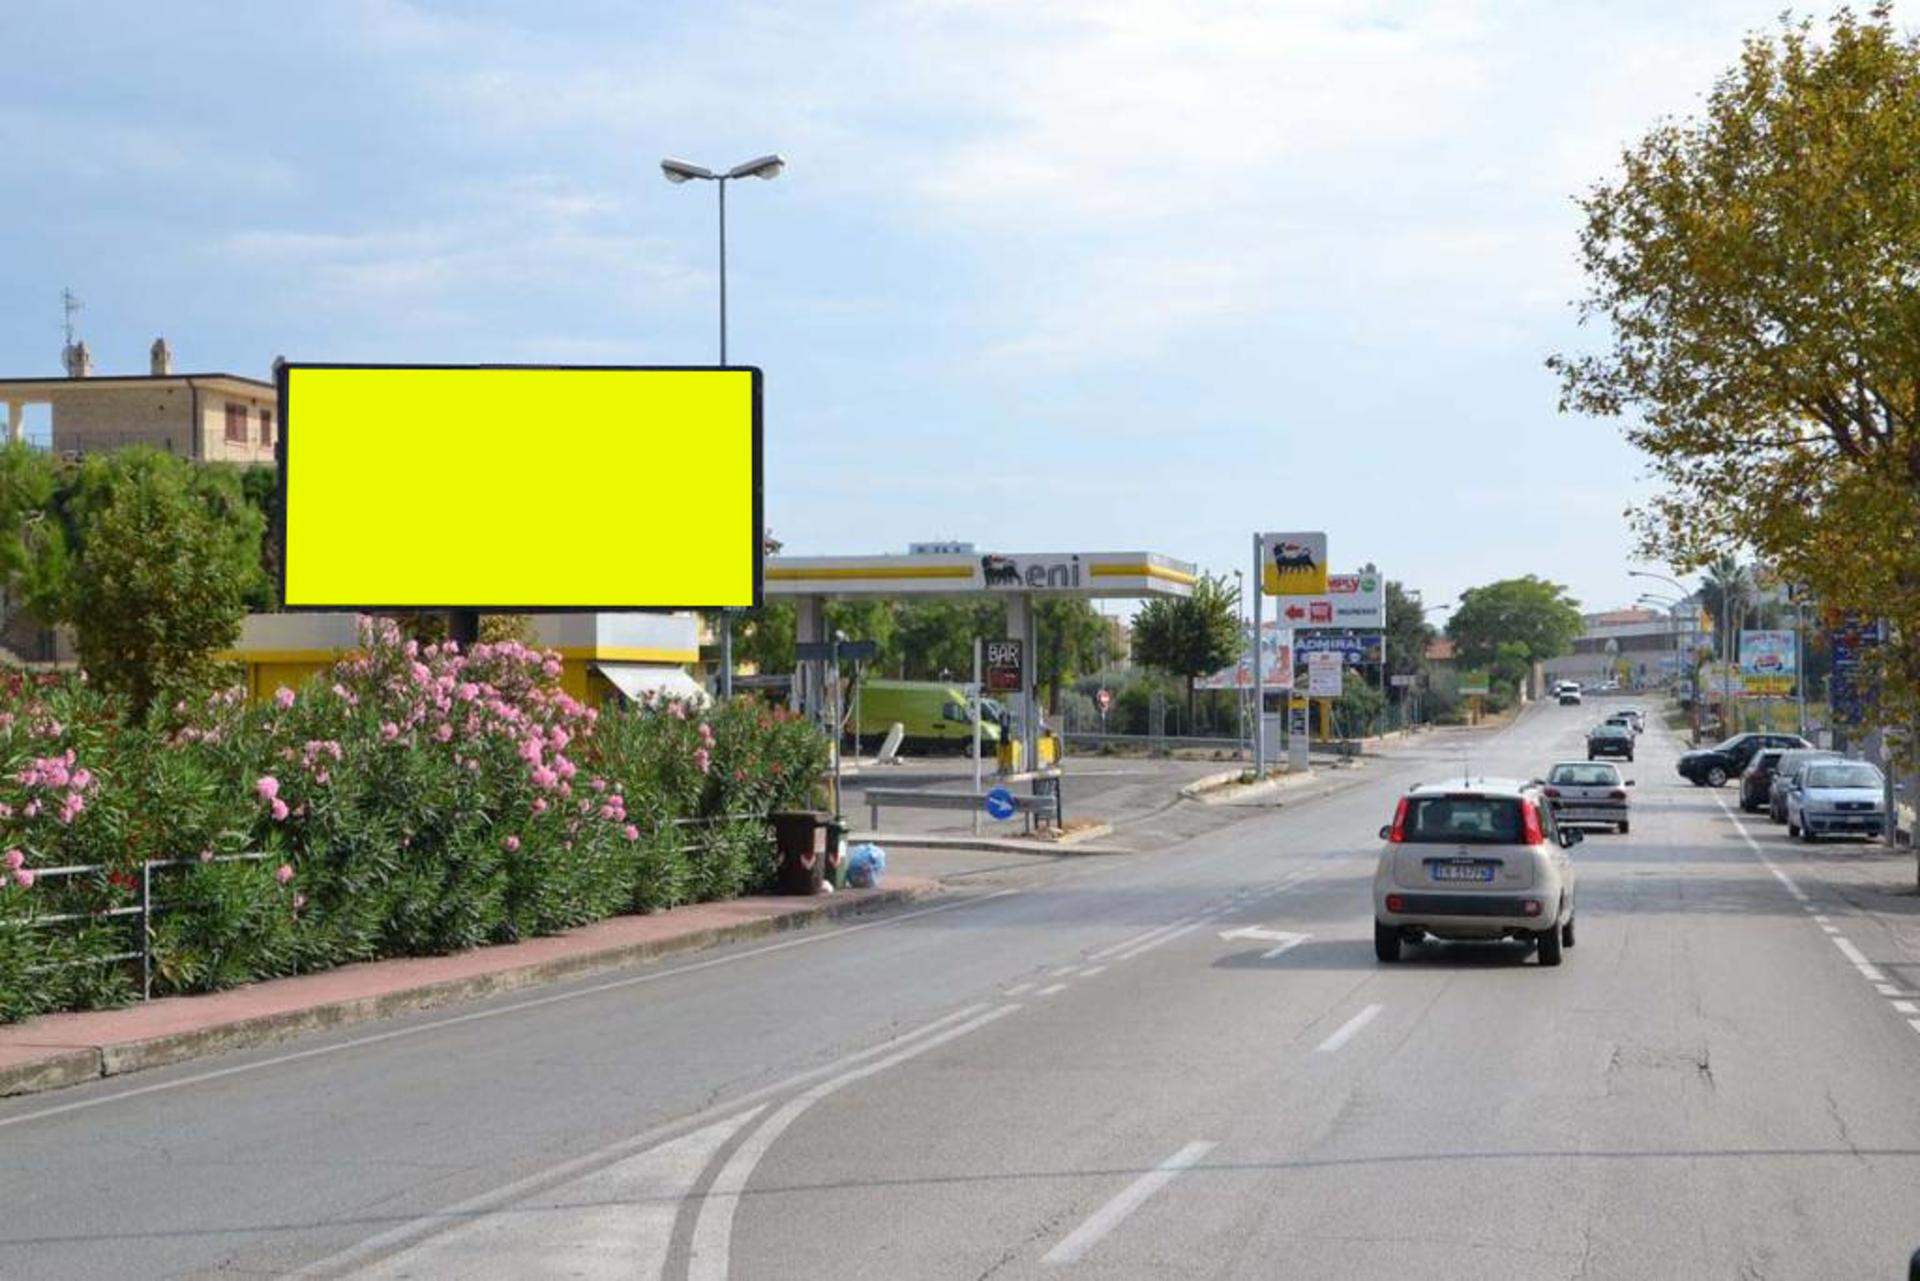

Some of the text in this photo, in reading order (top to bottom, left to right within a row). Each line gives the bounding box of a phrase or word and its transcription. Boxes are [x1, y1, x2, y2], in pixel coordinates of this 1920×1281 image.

[1025, 555, 1079, 588] eni
[988, 643, 1019, 667] BAR
[1295, 638, 1366, 651] ADMIRAL
